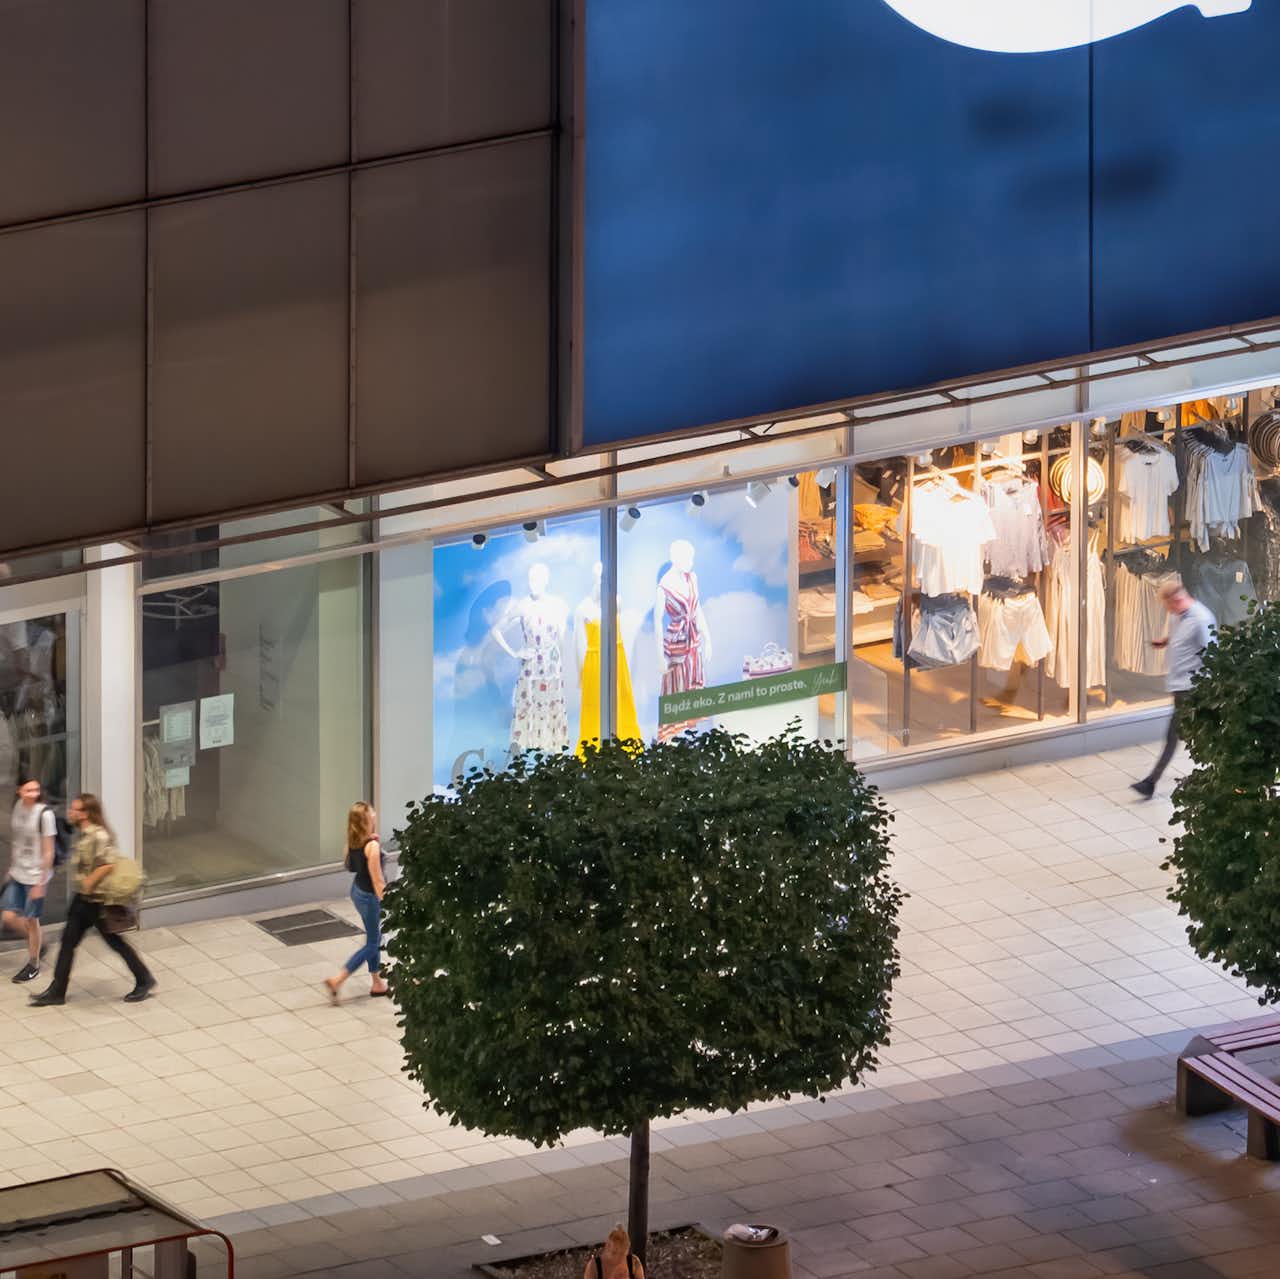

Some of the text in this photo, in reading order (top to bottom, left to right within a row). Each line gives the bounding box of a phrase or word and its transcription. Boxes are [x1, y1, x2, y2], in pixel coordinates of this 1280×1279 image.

[718, 692, 726, 704] Z
[728, 686, 754, 702] nami
[756, 686, 768, 697] to
